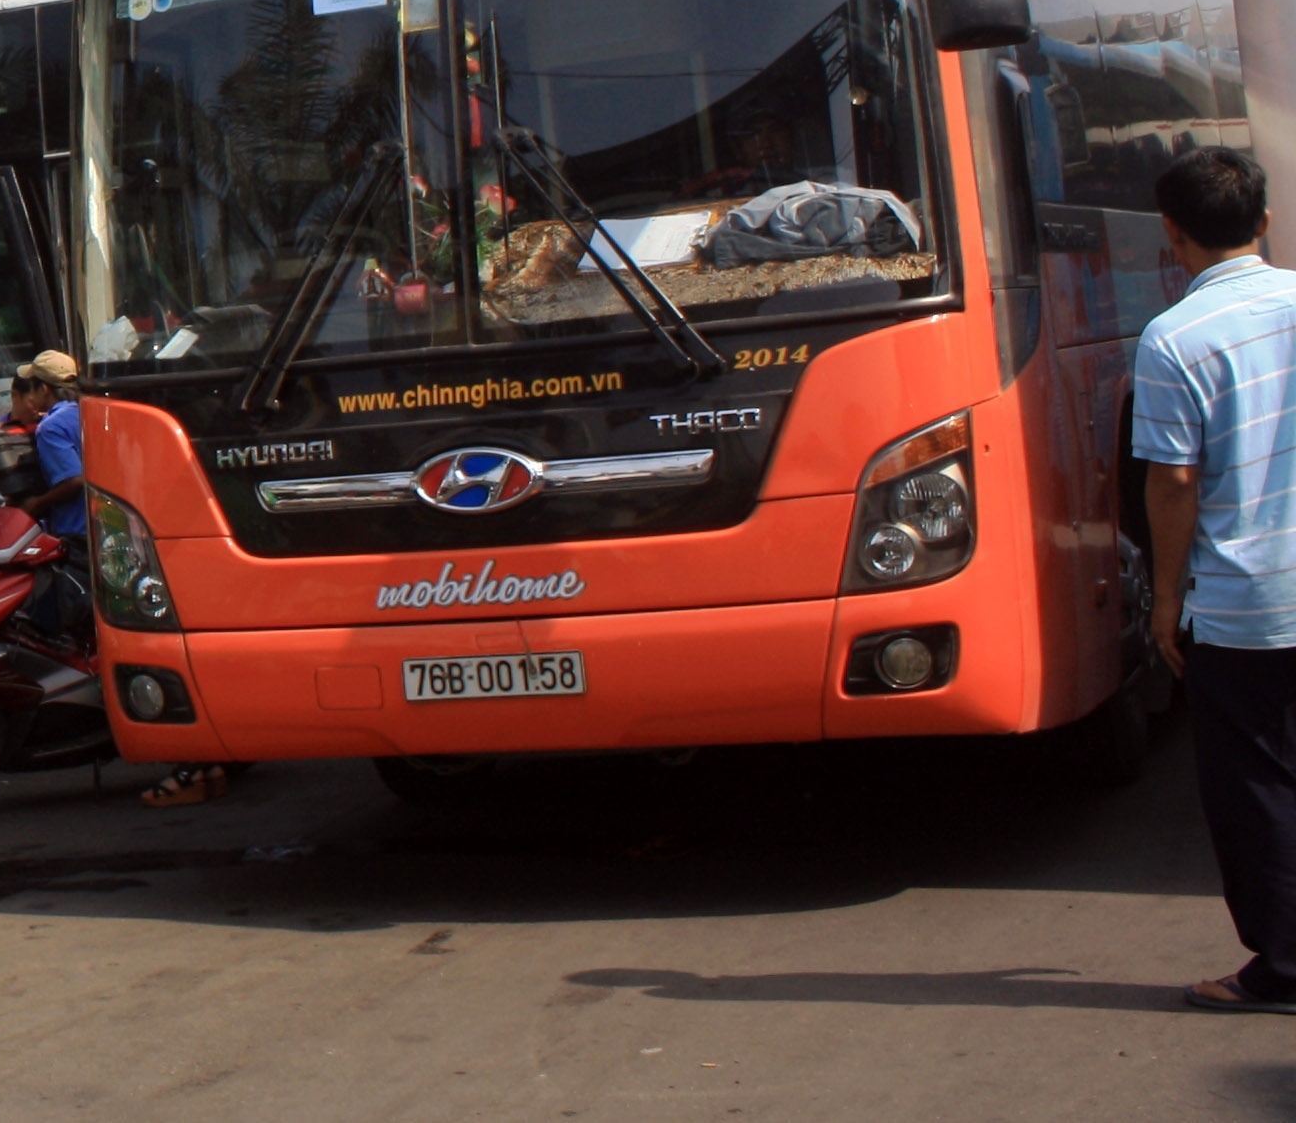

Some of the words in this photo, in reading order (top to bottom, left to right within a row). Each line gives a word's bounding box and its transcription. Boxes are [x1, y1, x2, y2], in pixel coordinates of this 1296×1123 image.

[733, 344, 810, 370] 2014
[339, 371, 622, 414] www.chinnghia.com.vn
[649, 408, 760, 435] THACO
[216, 440, 333, 469] HYUNDAI
[376, 559, 586, 609] mobihome
[410, 657, 576, 696] 76B-001.58
